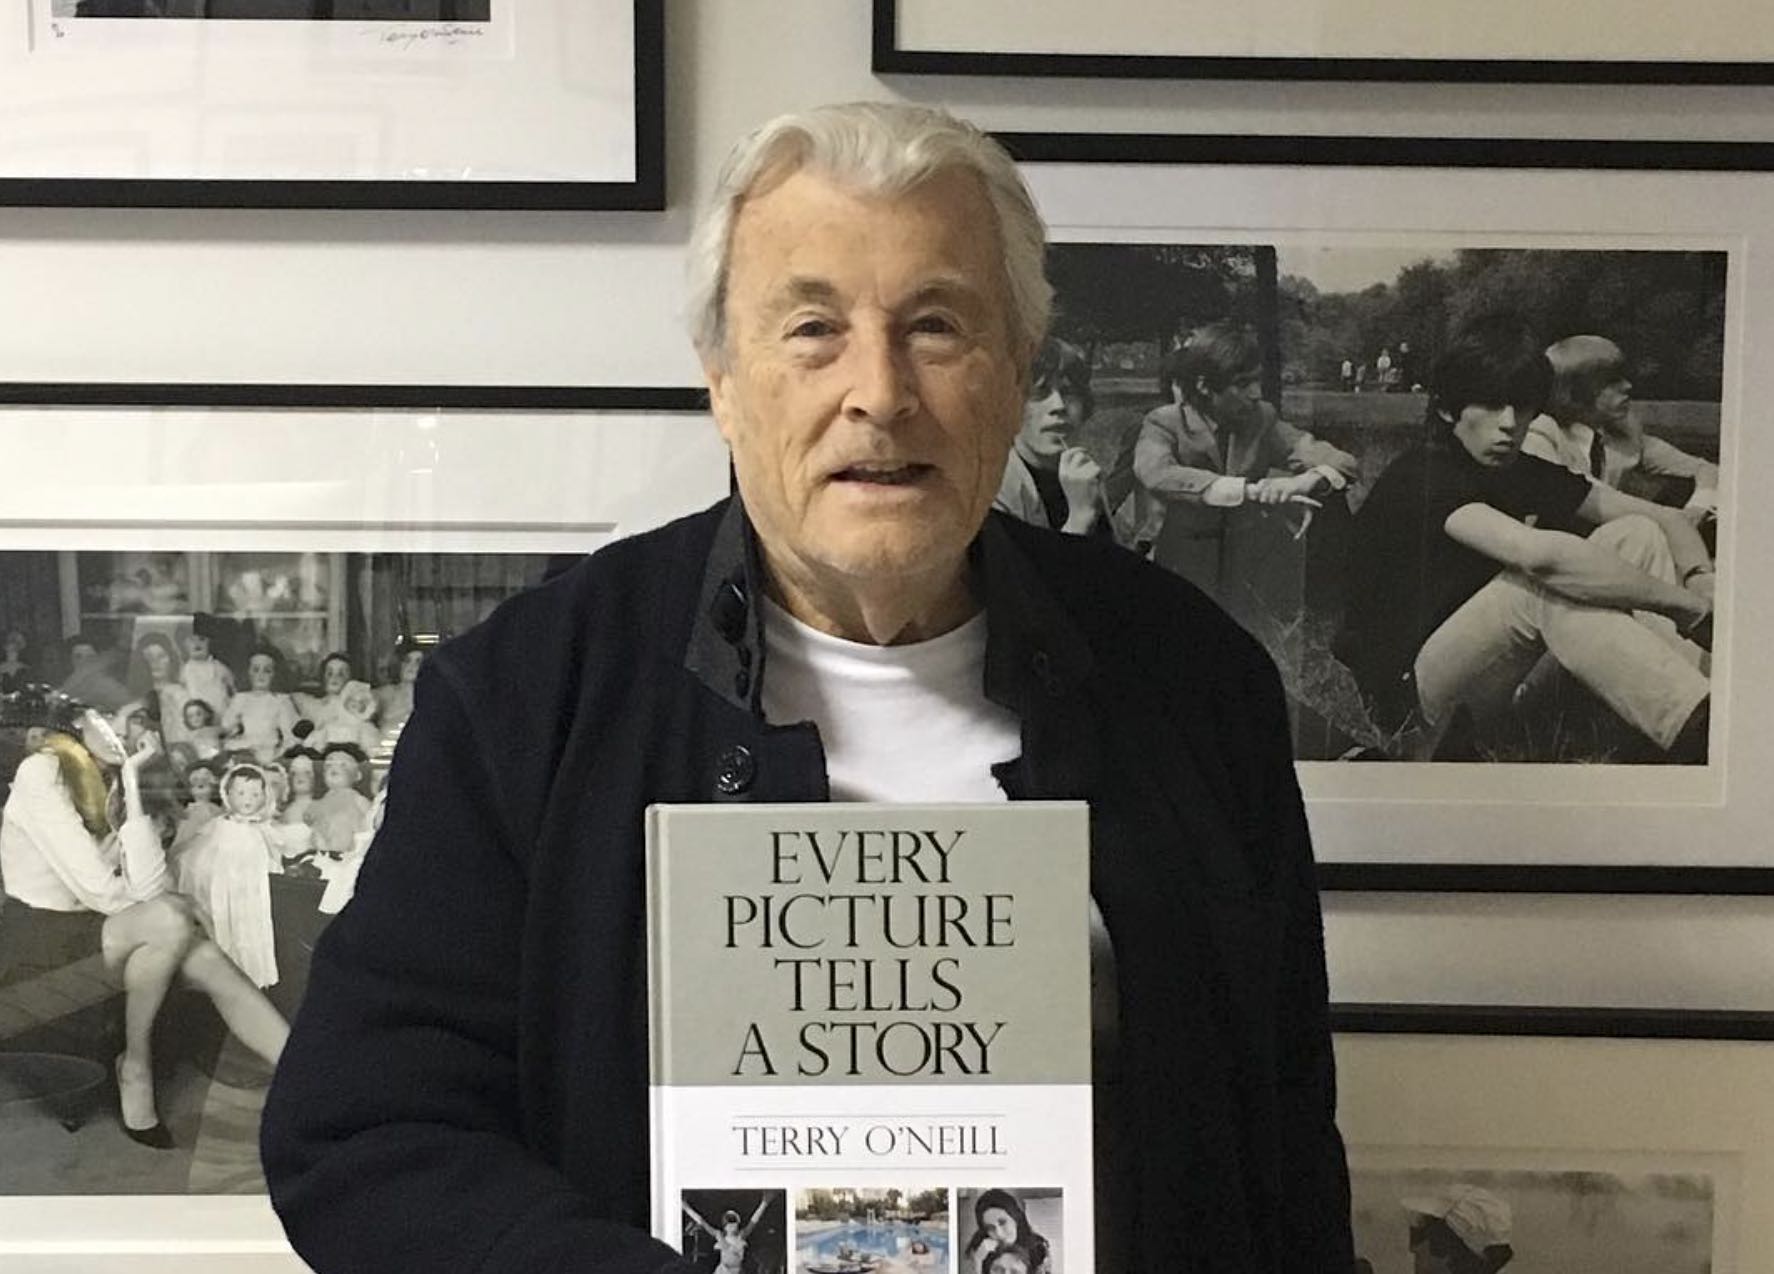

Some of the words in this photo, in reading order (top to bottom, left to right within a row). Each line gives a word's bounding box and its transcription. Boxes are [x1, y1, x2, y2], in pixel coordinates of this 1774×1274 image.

[769, 830, 966, 885] EVERY
[723, 893, 1015, 949] PICTURE
[774, 957, 963, 1012] TELLS
[731, 1022, 778, 1076] A
[797, 1021, 1007, 1077] STORY
[732, 1126, 849, 1156] TERRY
[865, 1125, 1008, 1156] O'NEILL
